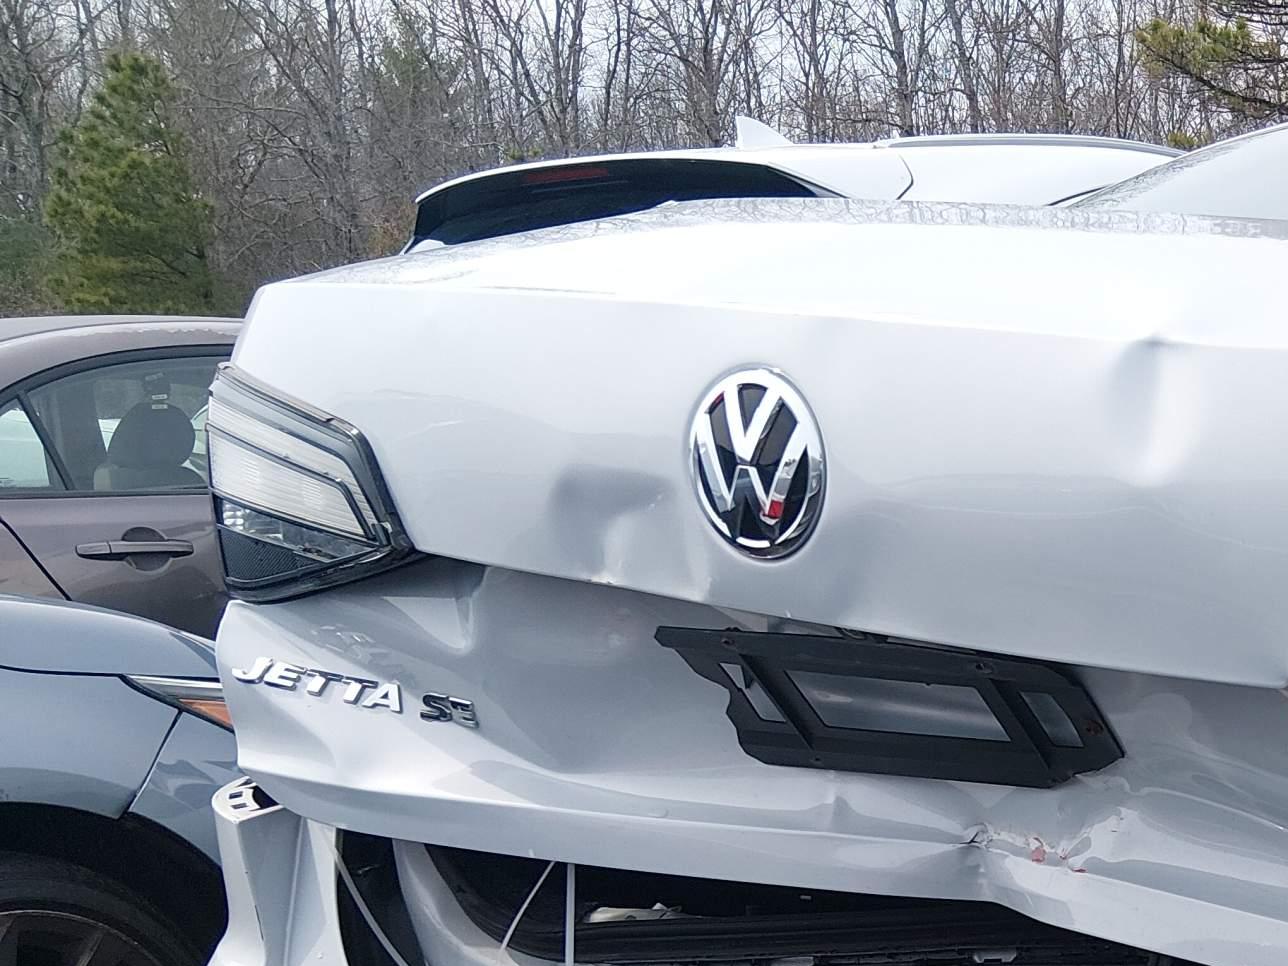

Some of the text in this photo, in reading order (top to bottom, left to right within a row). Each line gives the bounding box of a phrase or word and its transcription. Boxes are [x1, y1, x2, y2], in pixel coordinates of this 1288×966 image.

[691, 372, 813, 534] VW
[232, 656, 479, 729] JETTA SE
